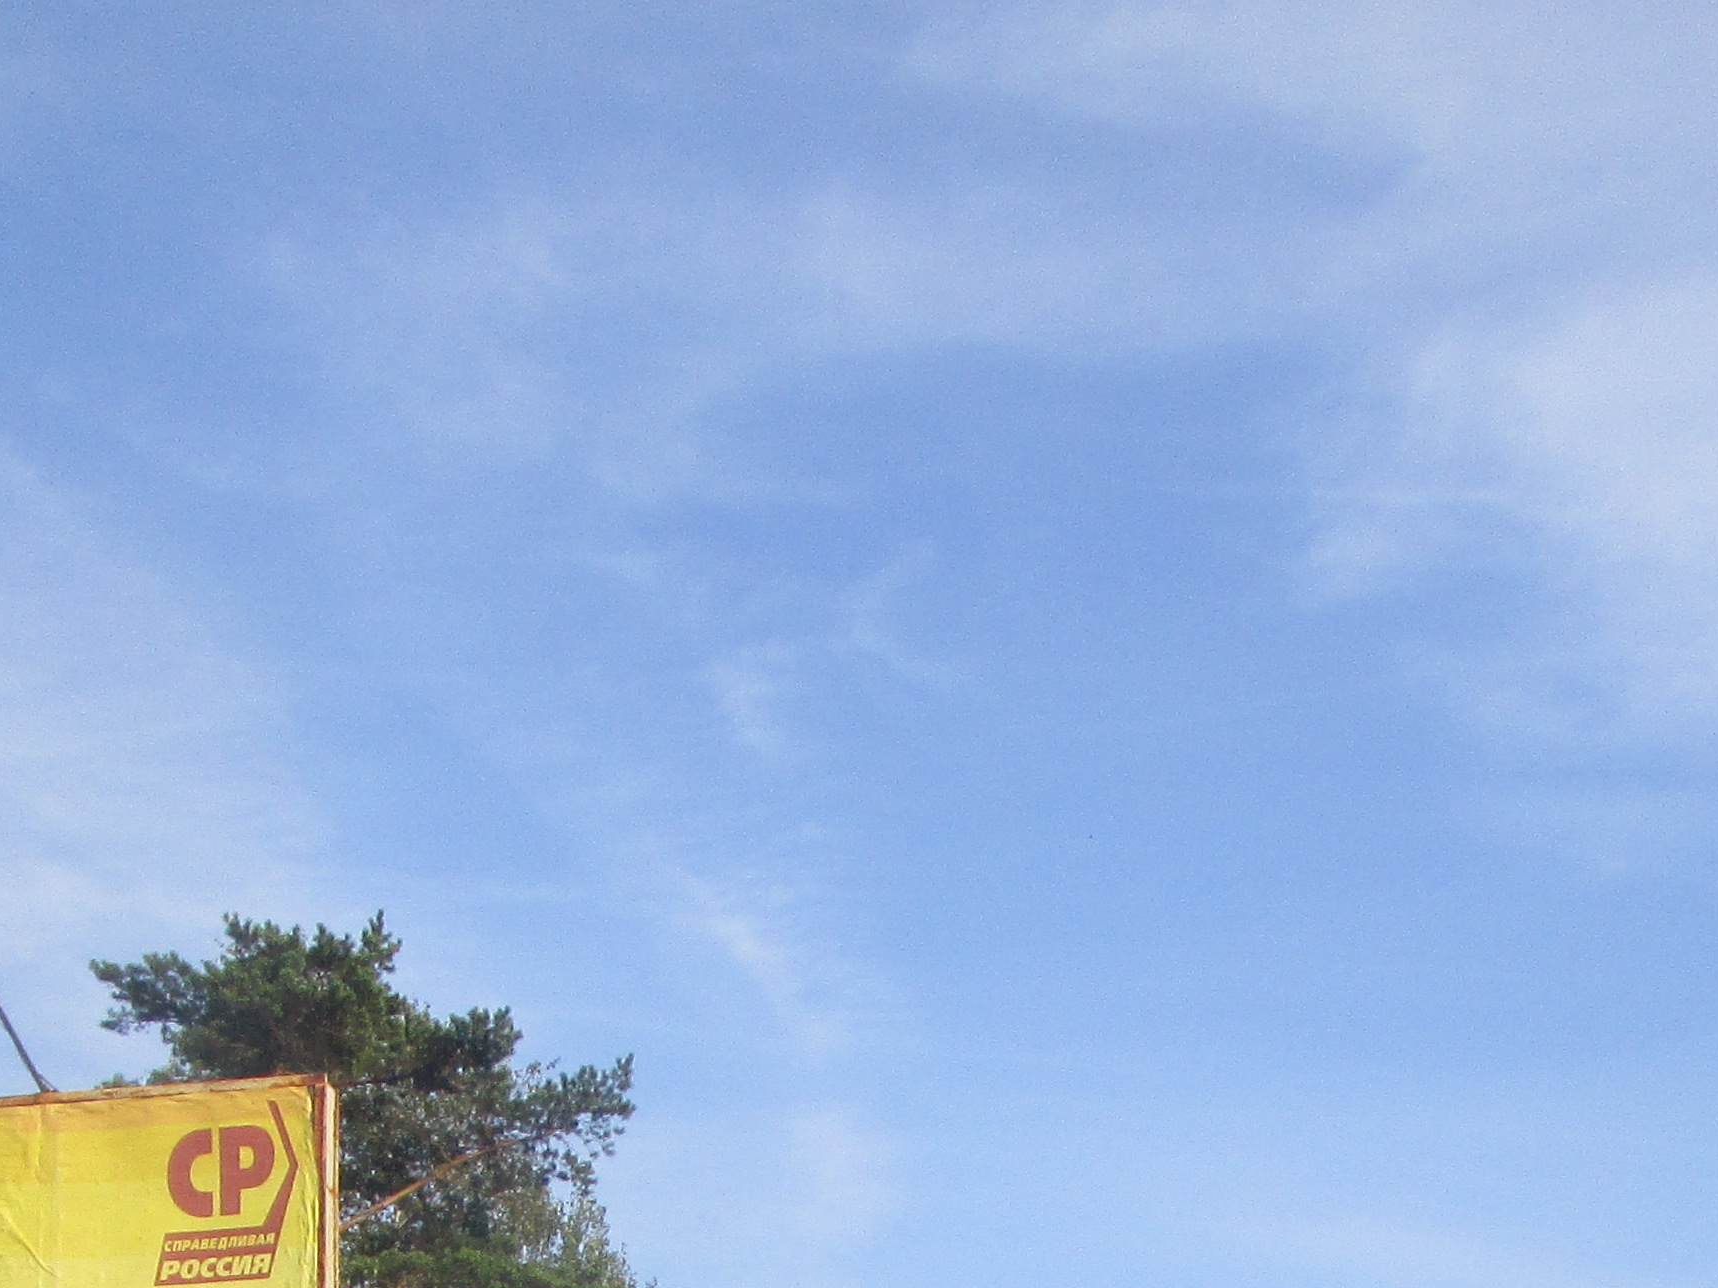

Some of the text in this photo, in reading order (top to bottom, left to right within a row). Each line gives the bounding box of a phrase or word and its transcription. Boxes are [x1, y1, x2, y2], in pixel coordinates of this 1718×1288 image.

[167, 1125, 275, 1218] СР
[164, 1232, 275, 1252] СПРАВЕДЛИВАЯ
[159, 1253, 272, 1281] РОССИЯ
